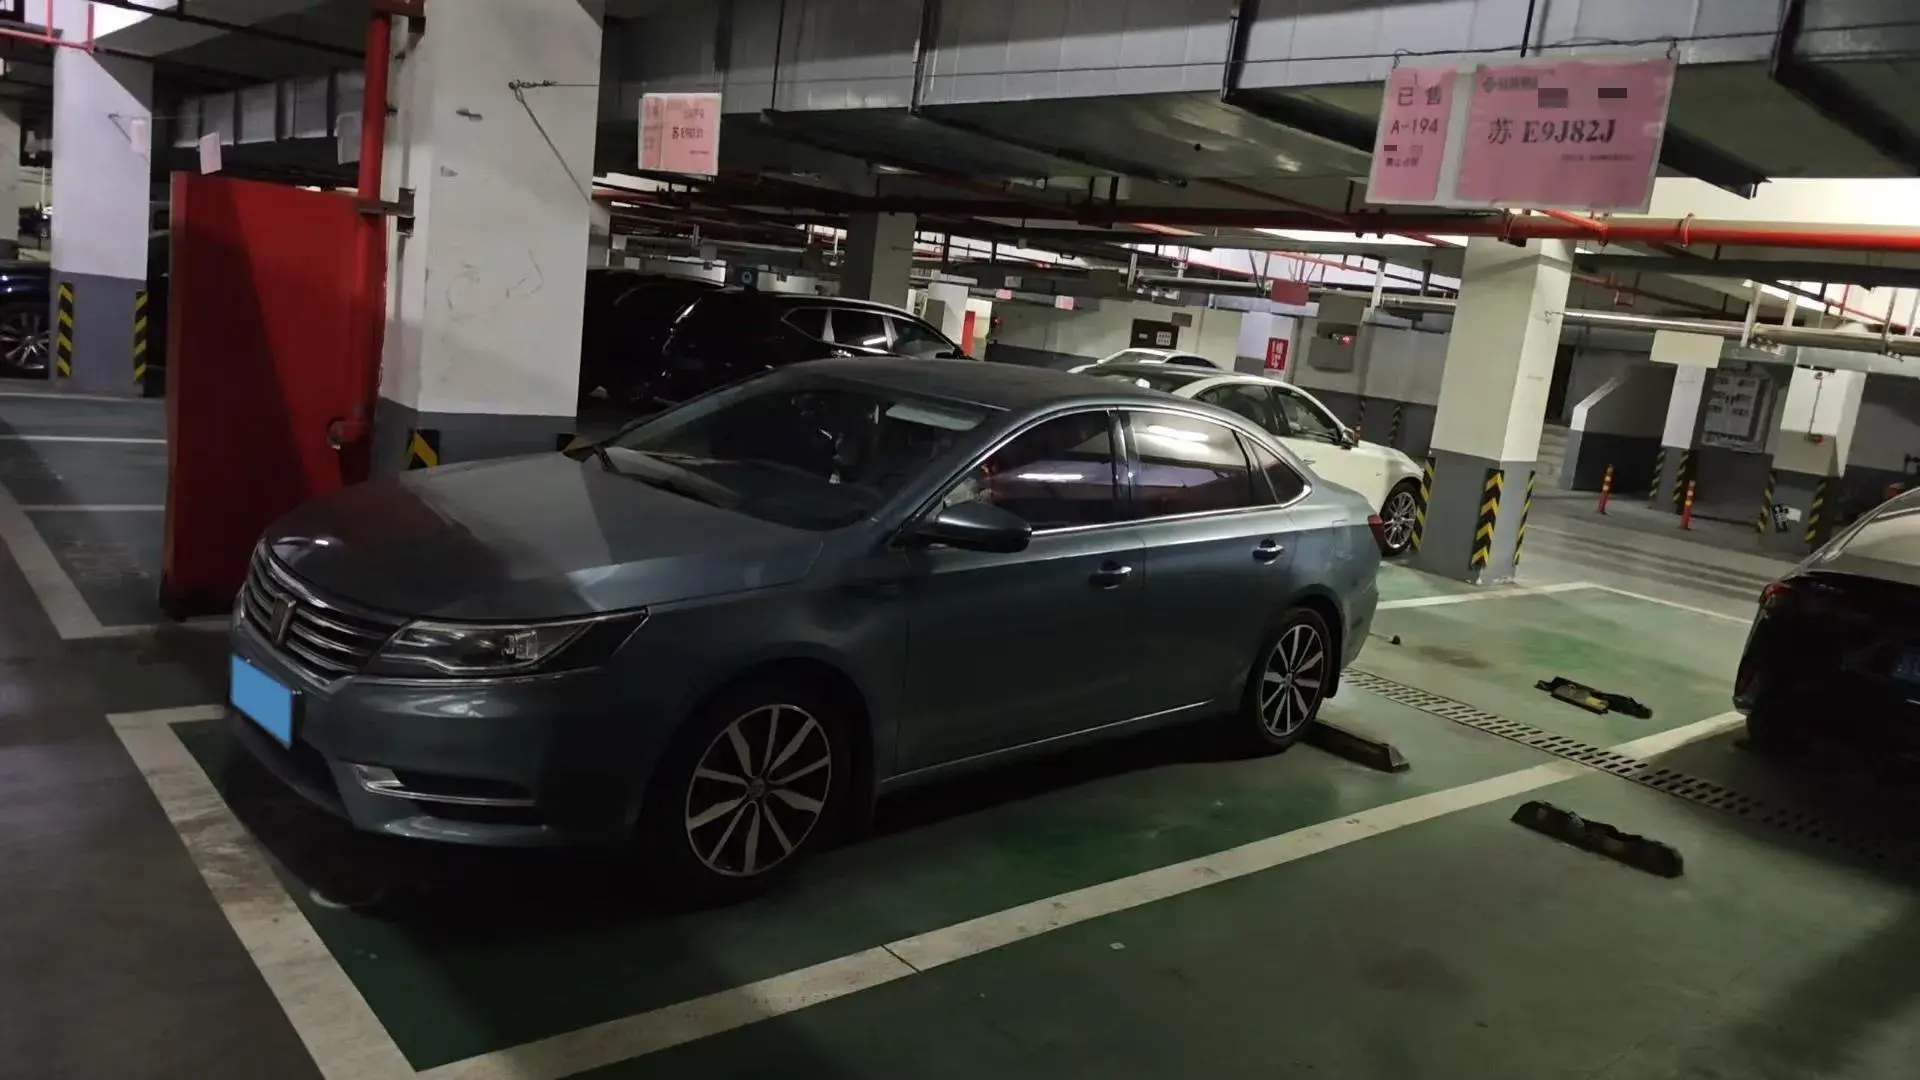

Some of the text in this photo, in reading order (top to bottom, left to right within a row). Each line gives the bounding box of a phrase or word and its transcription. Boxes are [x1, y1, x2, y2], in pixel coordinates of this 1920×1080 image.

[1390, 118, 1439, 135] A-194
[1488, 118, 1616, 145] 苏 E9J82J
